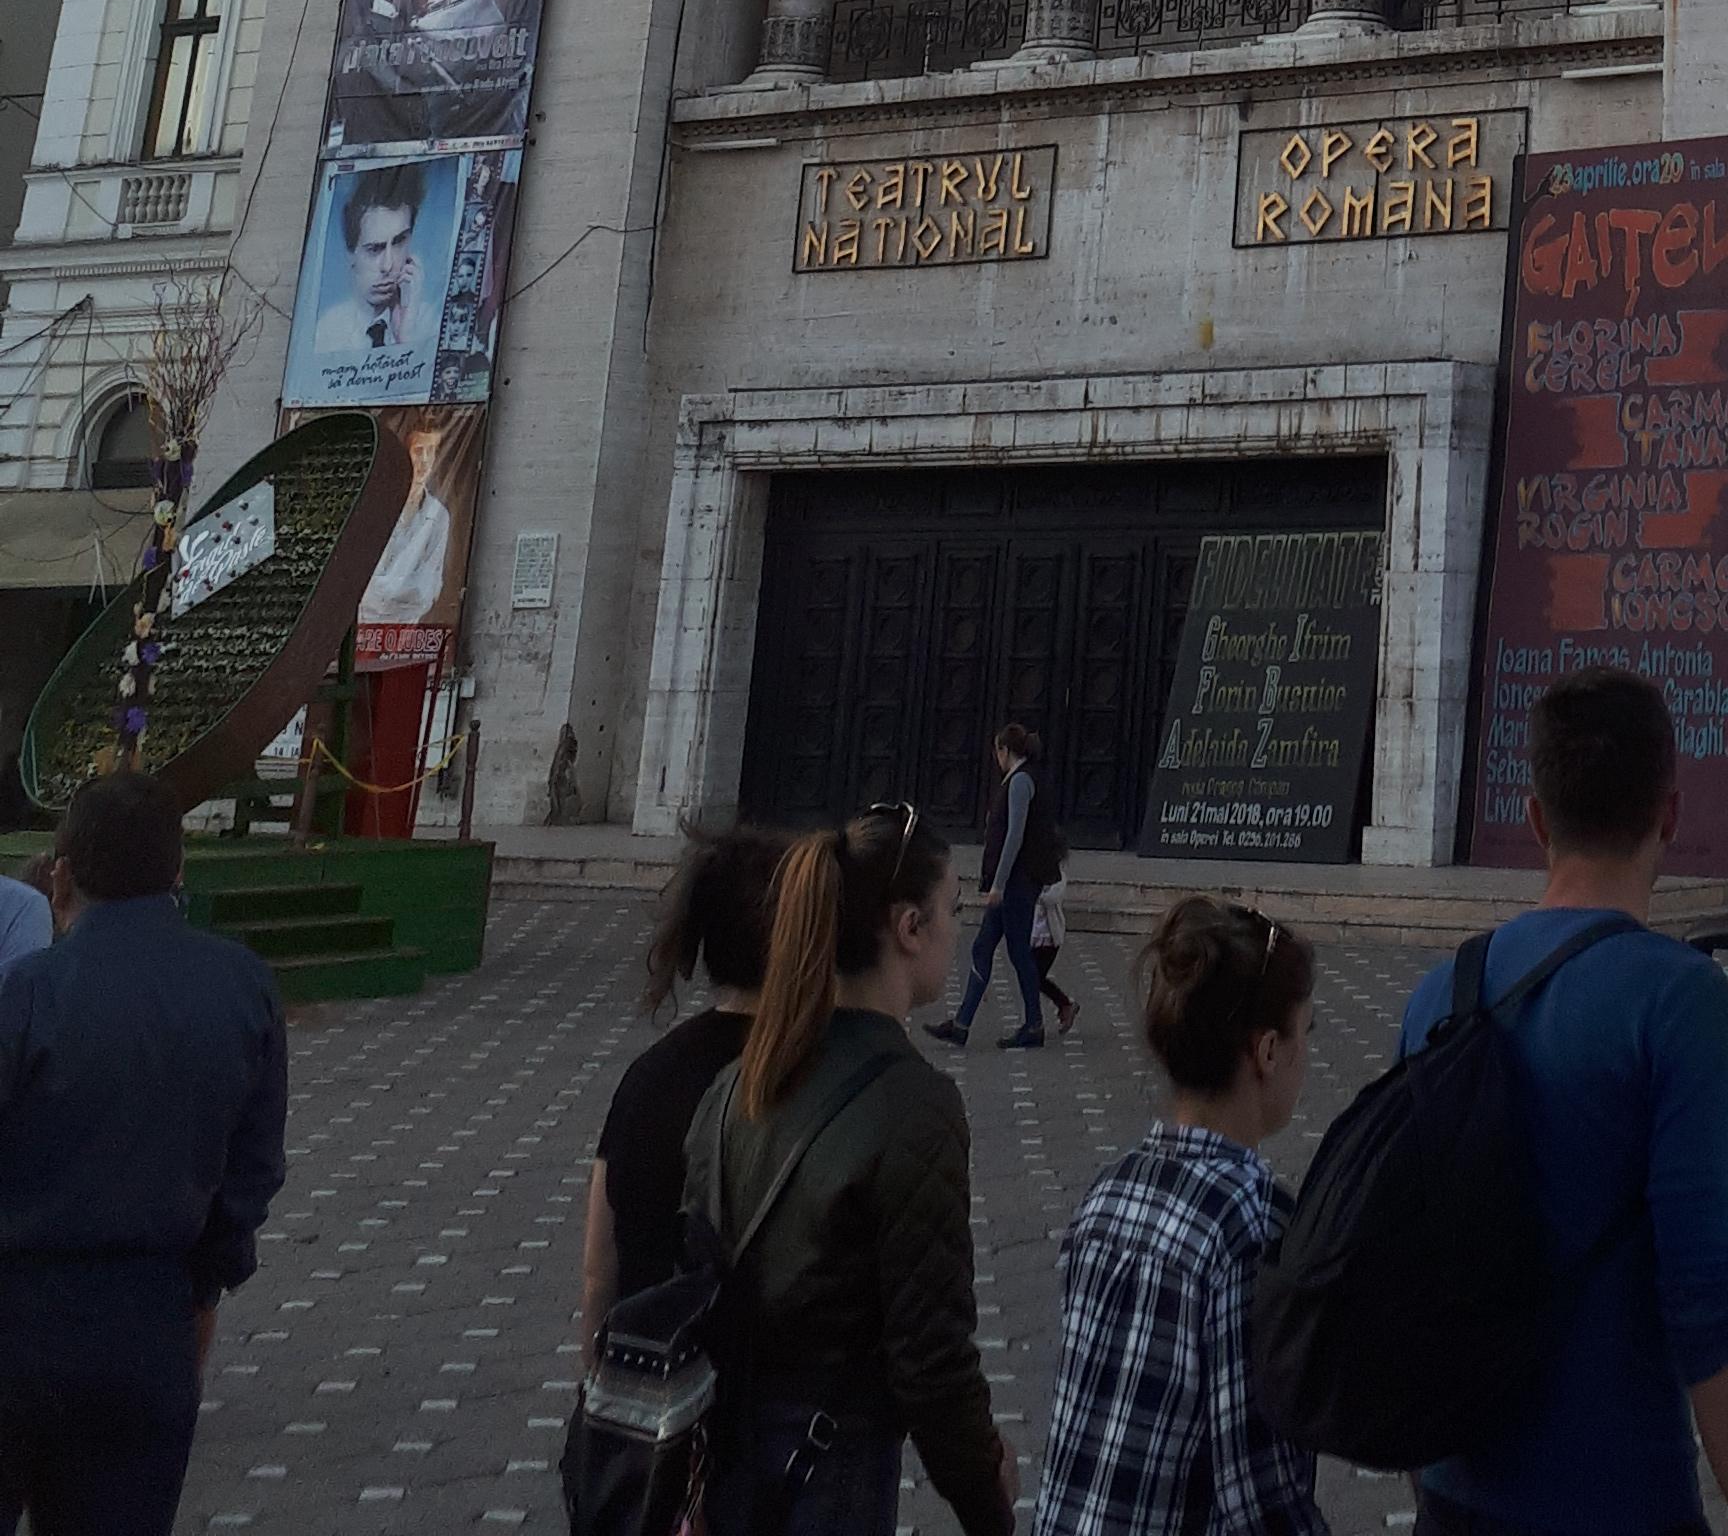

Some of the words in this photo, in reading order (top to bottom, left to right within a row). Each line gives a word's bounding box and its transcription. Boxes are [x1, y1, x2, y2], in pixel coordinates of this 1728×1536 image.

[1280, 117, 1478, 180] OPERA
[1704, 157, 1725, 179] sala
[1257, 176, 1493, 242] ROMANA
[803, 206, 1034, 266] NATIONAL
[1527, 312, 1677, 358] FLORINA
[384, 362, 426, 391] prost
[1516, 469, 1682, 512] VIRGINIA
[1516, 508, 1628, 551] ROGIN
[1201, 615, 1288, 667] Gheorghe
[1288, 613, 1352, 663] Ifrim
[1496, 636, 1553, 674] Ioana
[1638, 639, 1713, 678] Antonia
[1191, 665, 1258, 715] Florin
[1158, 718, 1249, 769] Adelaida
[1251, 718, 1341, 769] Zamfira
[1160, 800, 1190, 824] Luni
[1265, 809, 1292, 827] ora
[1294, 803, 1334, 829] 19.00
[1189, 829, 1220, 849] Operei
